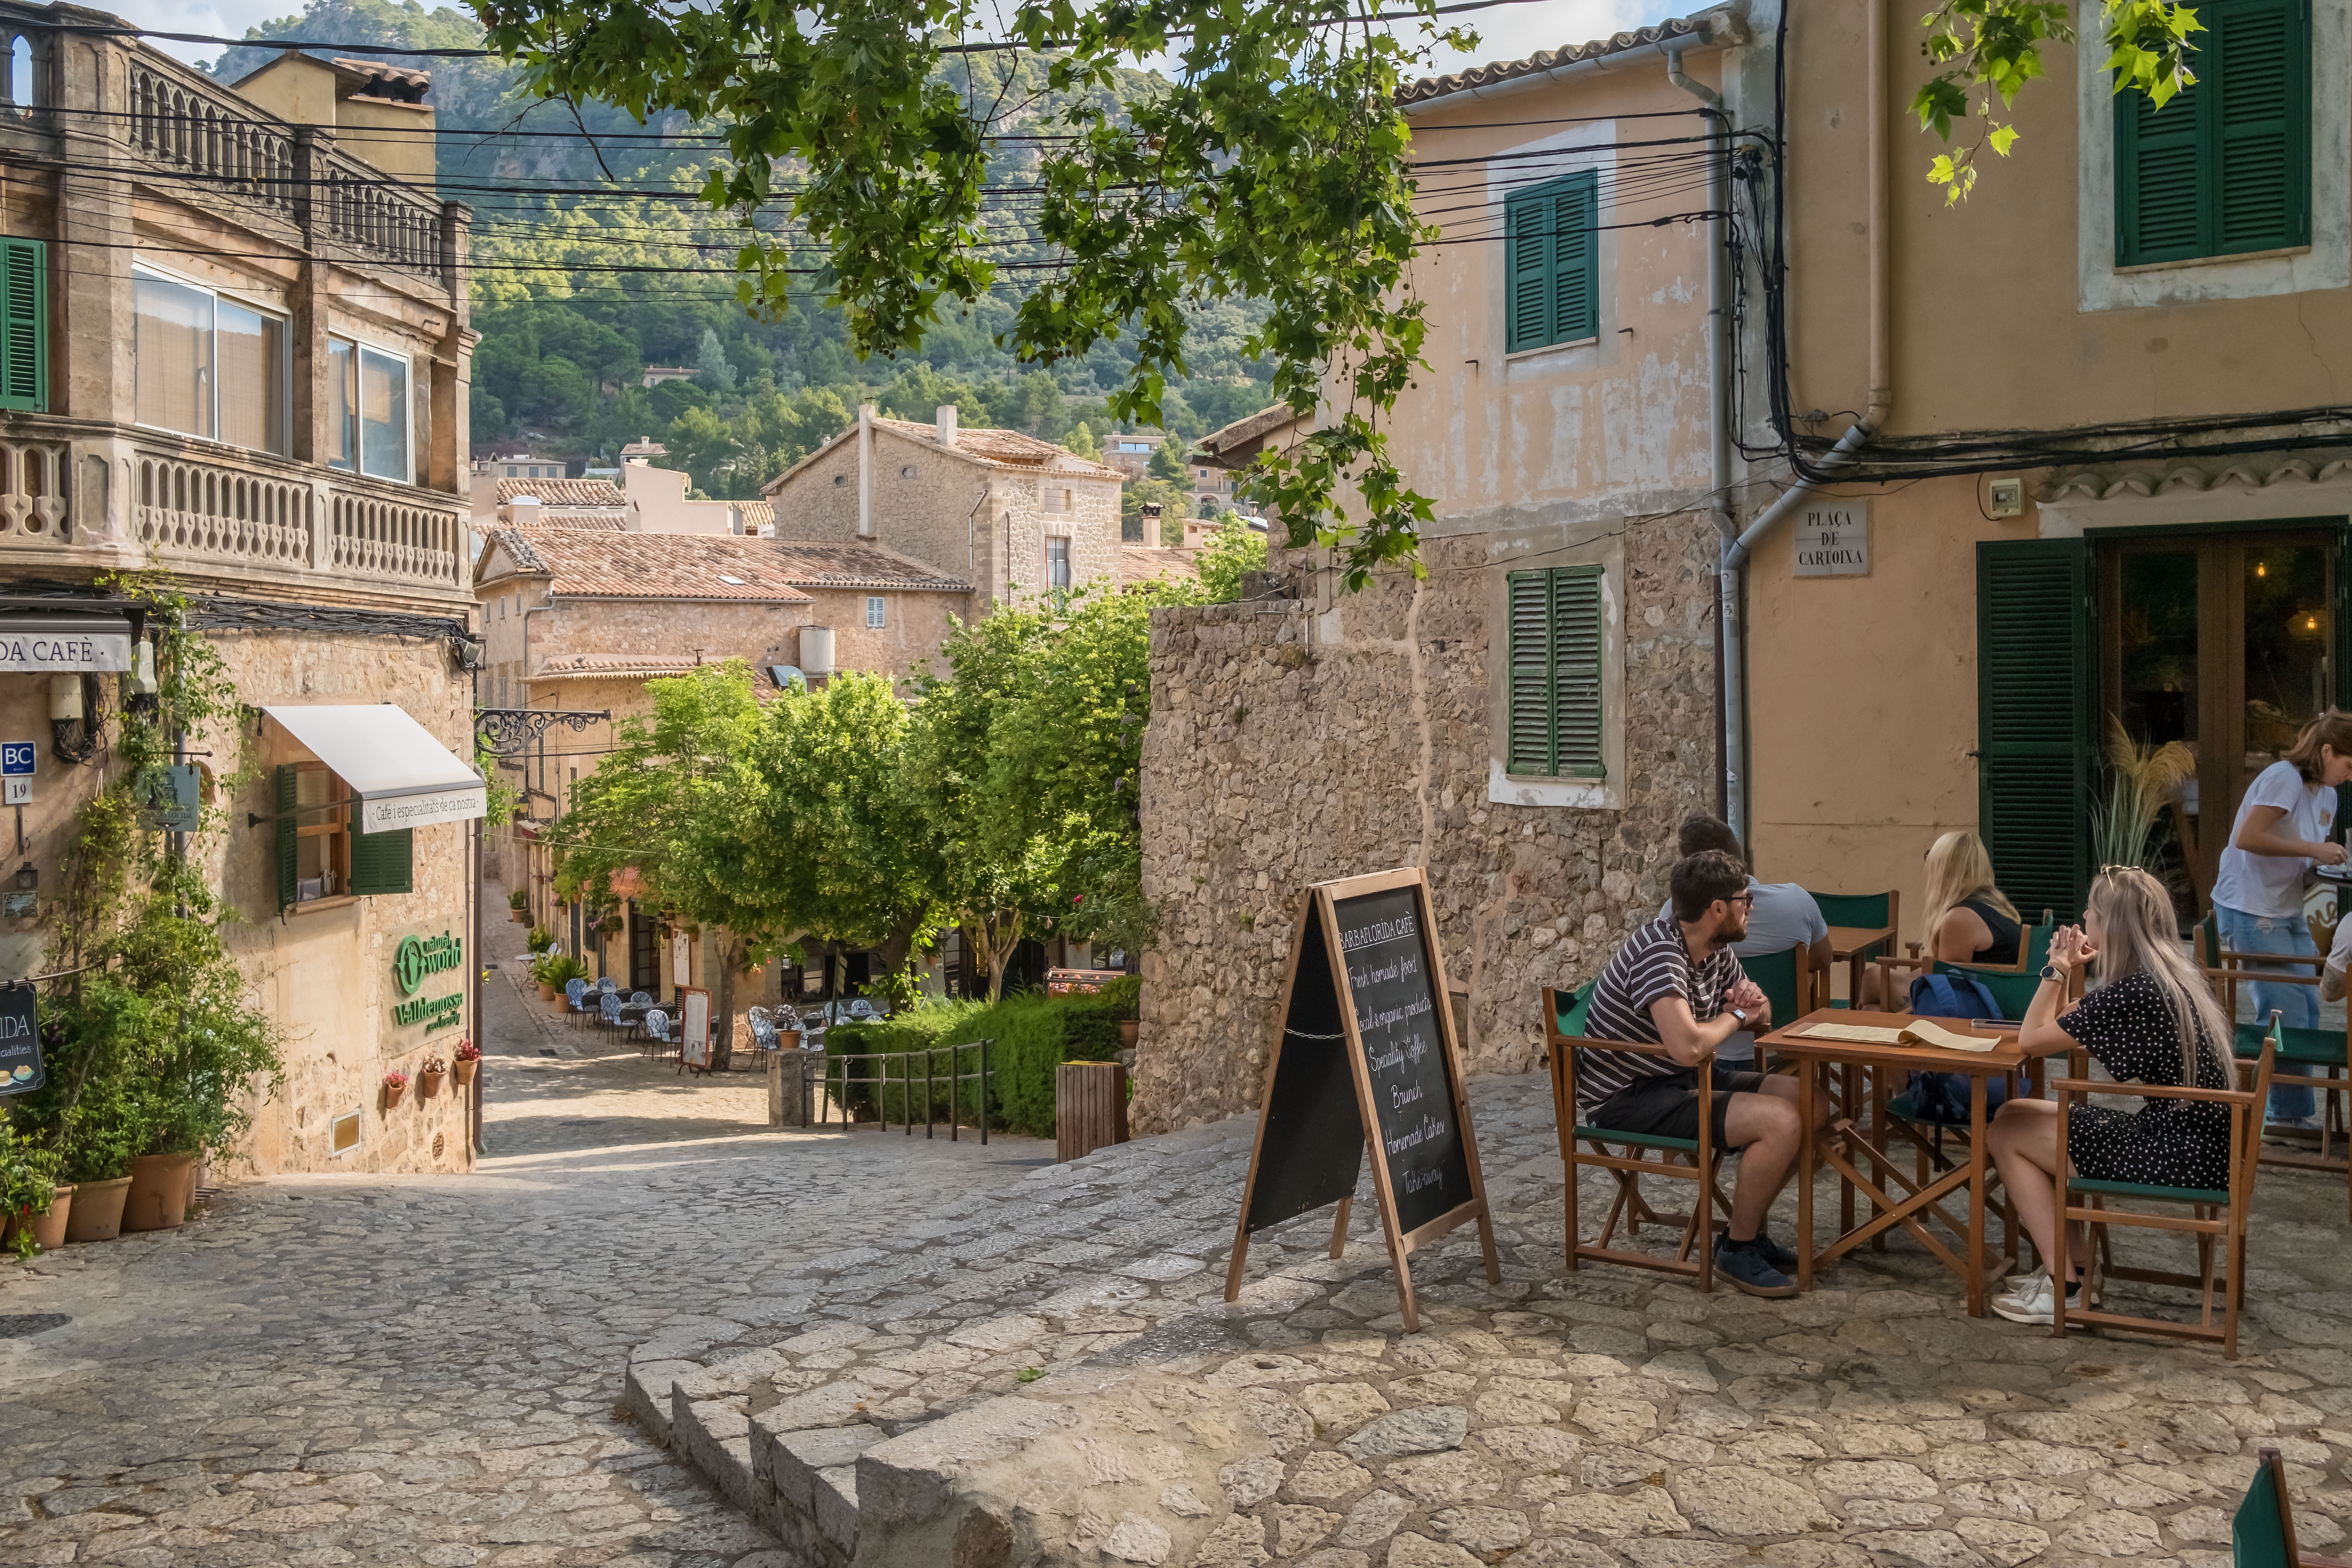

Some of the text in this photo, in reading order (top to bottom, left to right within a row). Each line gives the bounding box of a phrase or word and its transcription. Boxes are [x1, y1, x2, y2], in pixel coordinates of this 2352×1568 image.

[1808, 510, 1852, 527] PLAÇA
[1821, 531, 1840, 546] DE
[1799, 549, 1863, 566] CARTOIXA
[33, 636, 92, 662] CAFÈ
[5, 747, 31, 765] BC
[12, 783, 26, 798] 19
[377, 797, 476, 821] Cafè i especialitats de ca nostra
[1396, 911, 1414, 935] CAFÈ
[424, 937, 462, 974] world
[1348, 966, 1369, 990] Fresh
[1401, 954, 1417, 982] food
[394, 993, 463, 1025] Valldemossa
[1379, 1004, 1403, 1033] organic
[1405, 992, 1432, 1026] products
[1369, 1033, 1427, 1078] Speciality Coffee
[1391, 1080, 1423, 1109] Brunch
[1385, 1125, 1423, 1156] Homemade
[1403, 1167, 1442, 1195] Take-away
